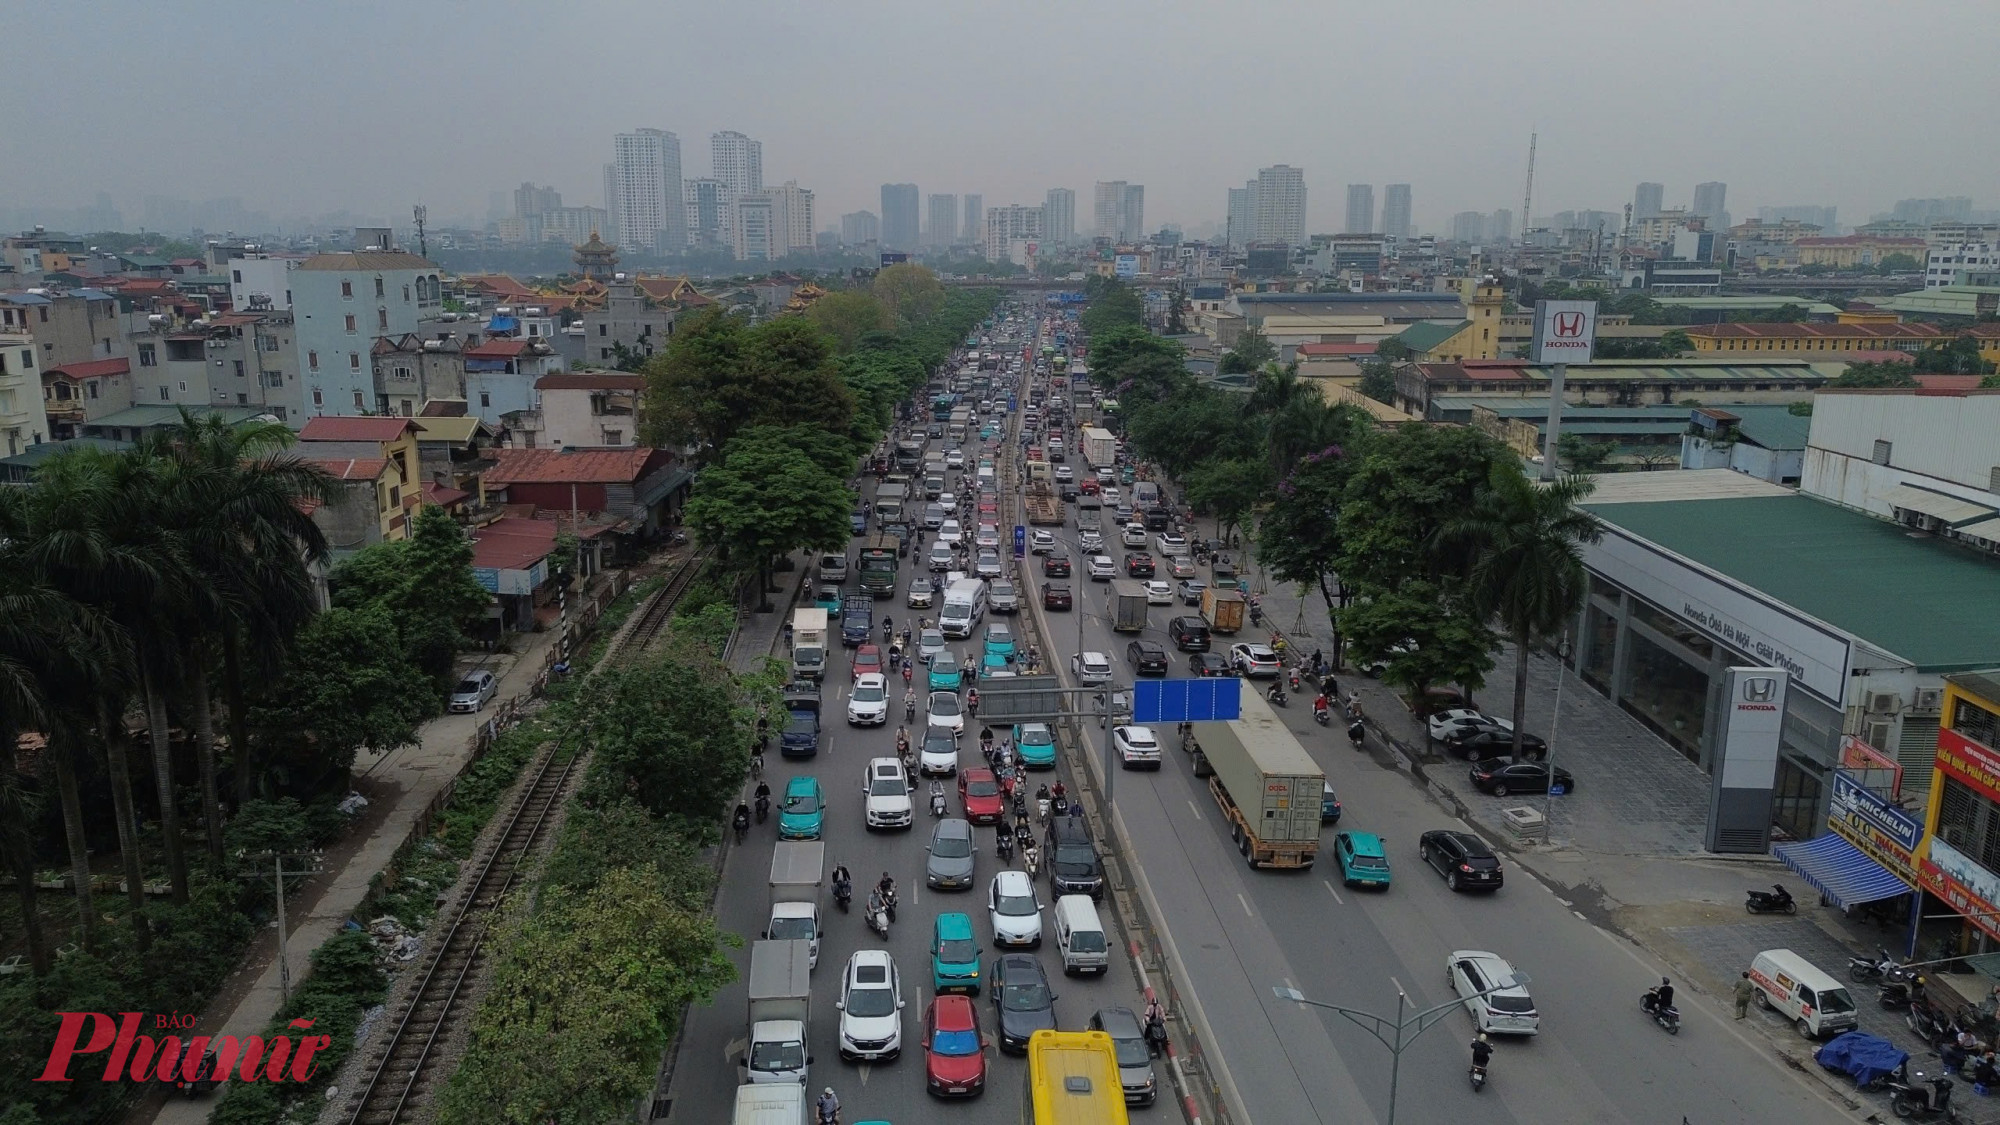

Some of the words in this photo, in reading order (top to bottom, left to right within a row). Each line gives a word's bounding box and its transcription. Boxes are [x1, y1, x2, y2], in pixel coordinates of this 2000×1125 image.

[1684, 603, 1707, 625] Honda
[1723, 624, 1734, 639] Hà
[1735, 631, 1750, 649] Nội
[1756, 641, 1773, 661] Giải
[1774, 652, 1804, 680] Phóng
[1859, 798, 1913, 838] MICHELIN
